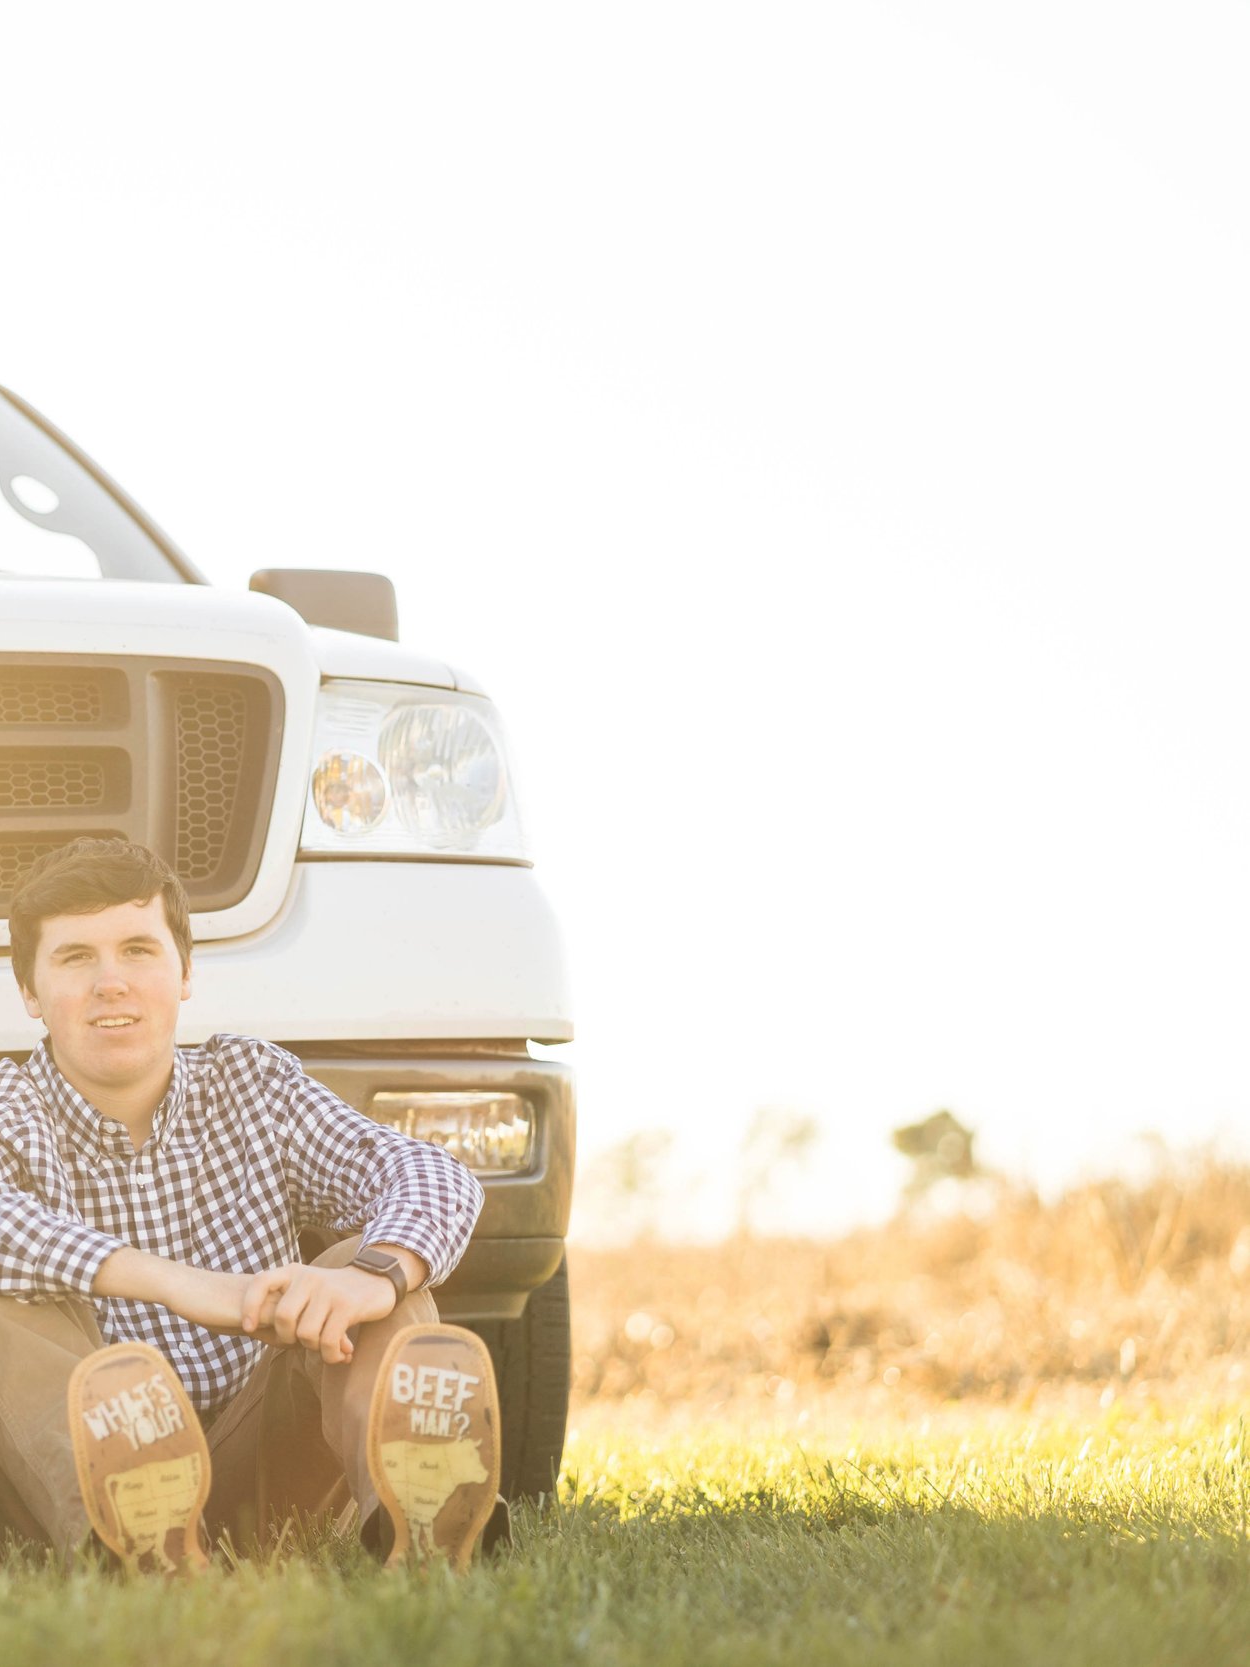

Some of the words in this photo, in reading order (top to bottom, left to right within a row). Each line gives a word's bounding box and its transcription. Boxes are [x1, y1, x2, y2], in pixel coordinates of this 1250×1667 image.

[392, 1363, 480, 1412] BEEF
[121, 1403, 184, 1451] YOUR
[411, 1408, 470, 1442] MAN?
